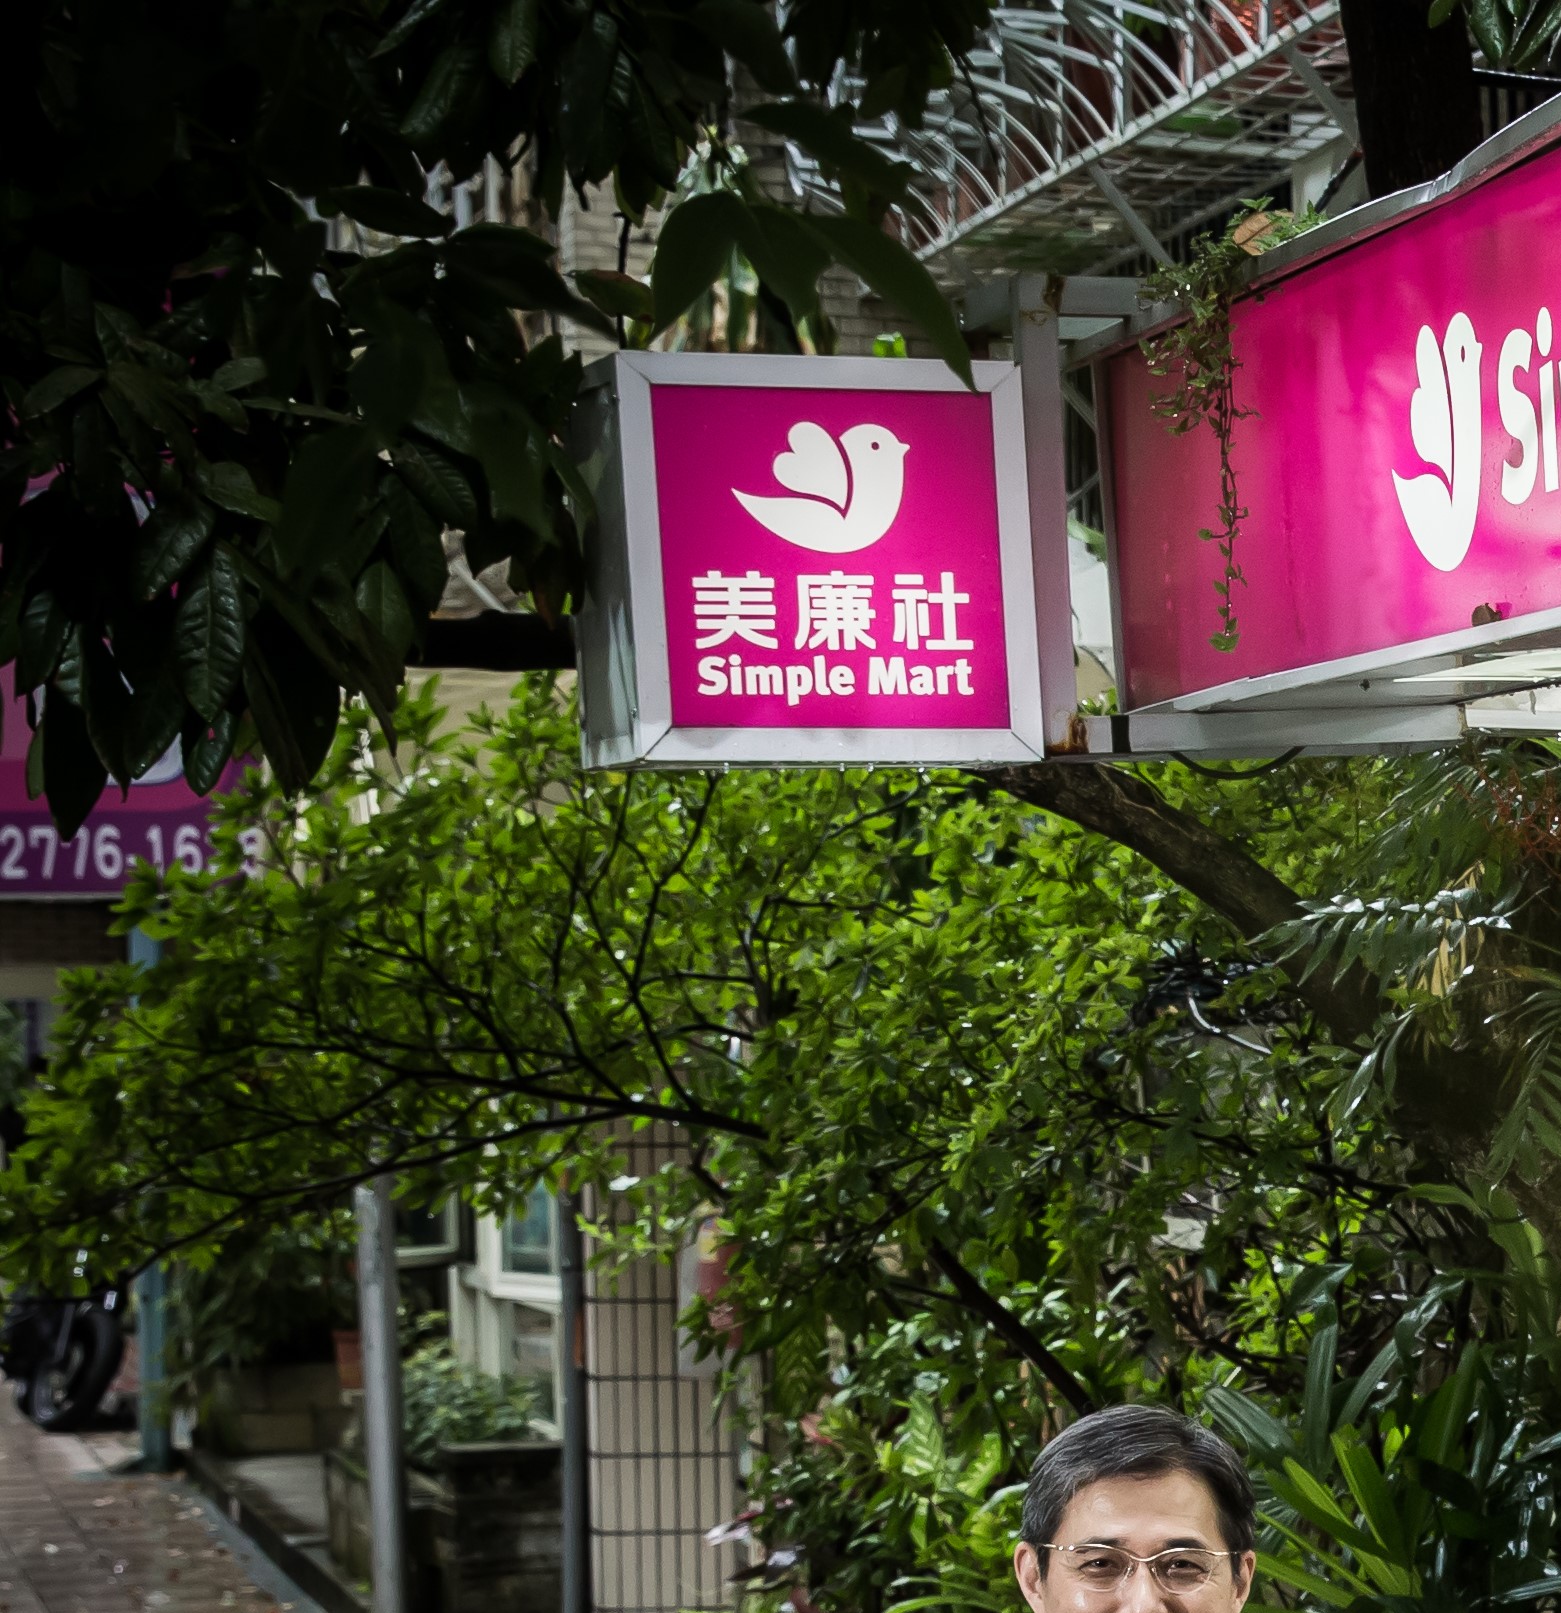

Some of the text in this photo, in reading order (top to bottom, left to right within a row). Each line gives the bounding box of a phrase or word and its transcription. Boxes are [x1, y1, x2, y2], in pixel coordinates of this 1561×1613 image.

[692, 570, 974, 651] 美廉社
[697, 655, 974, 706] Simple Mart
